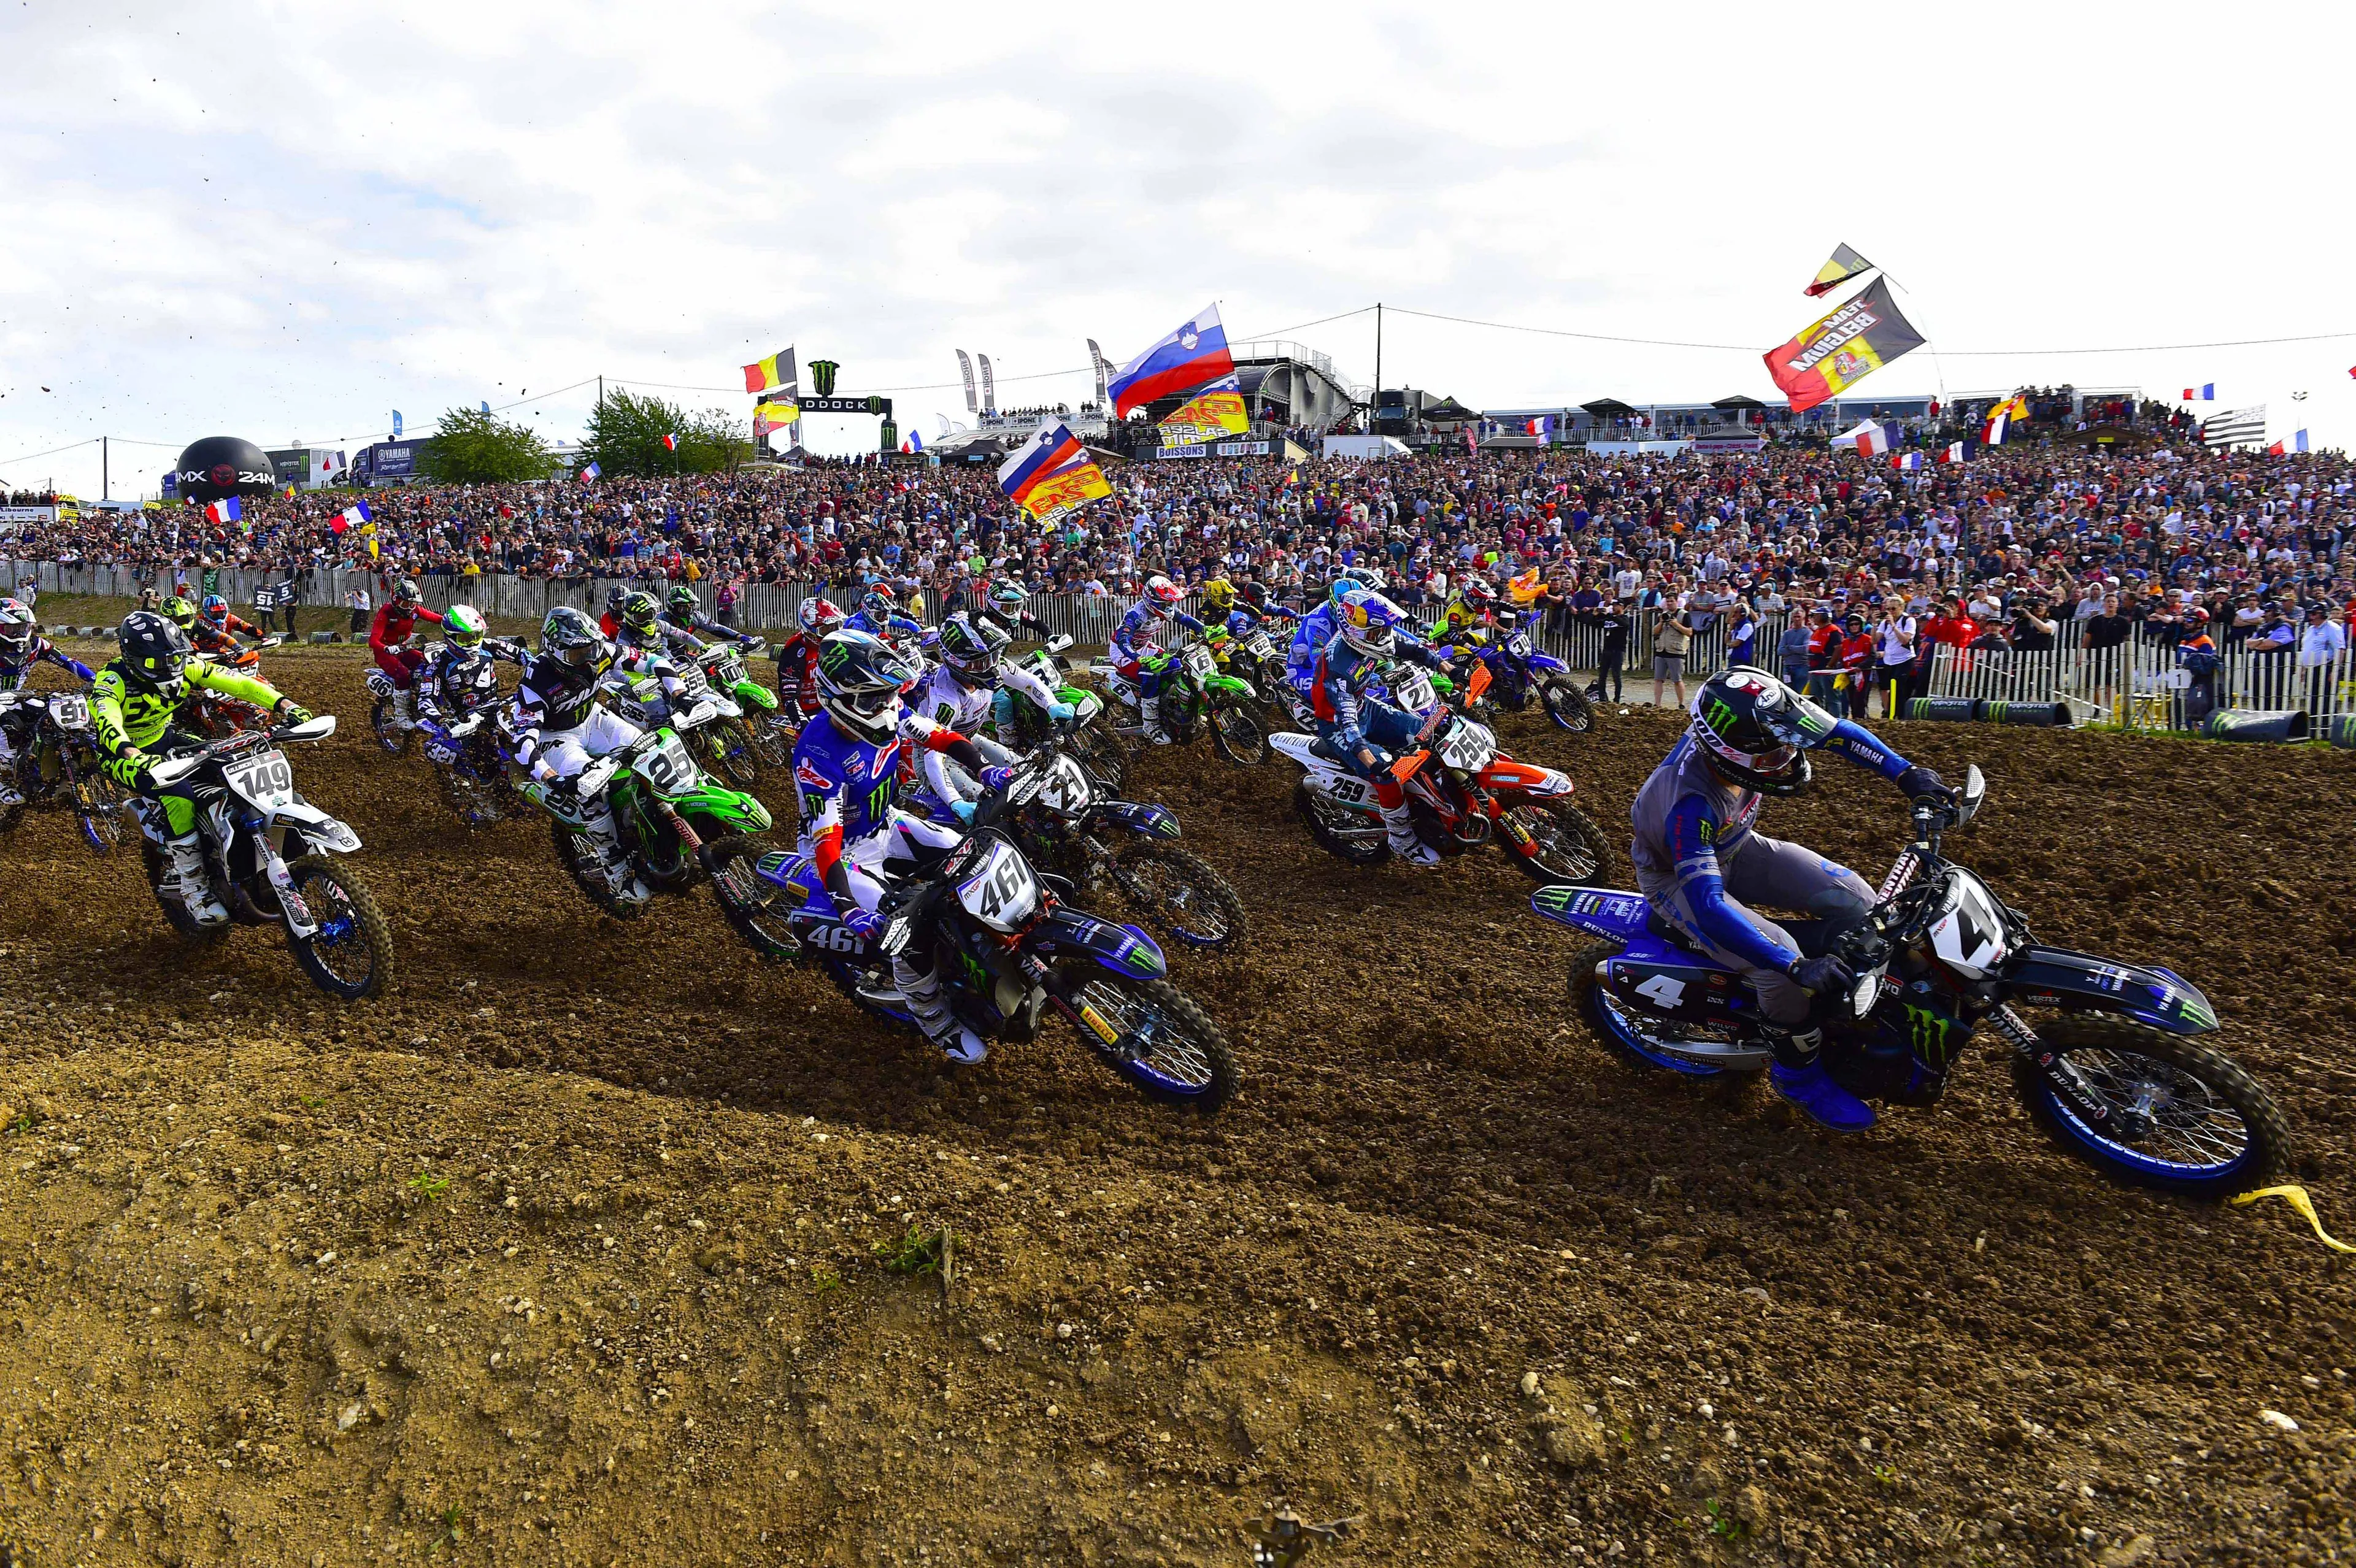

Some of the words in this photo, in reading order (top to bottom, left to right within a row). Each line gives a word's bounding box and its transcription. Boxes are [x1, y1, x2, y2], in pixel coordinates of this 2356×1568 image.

[385, 447, 410, 459] YAMAHA
[1159, 445, 1204, 458] BOISSONS
[257, 594, 274, 606] 15
[282, 586, 289, 597] 5
[1253, 638, 1271, 651] 62
[1513, 637, 1531, 656] 34
[1196, 654, 1209, 671] 6
[369, 677, 392, 695] 96
[1114, 681, 1128, 696] 6
[2176, 674, 2182, 686] 1
[1407, 682, 1431, 709] 22
[61, 702, 87, 724] 91
[217, 736, 259, 752] WRP
[428, 743, 456, 764] 321
[1276, 745, 1295, 755] DUNLOP
[1450, 726, 1486, 769] 259
[1850, 740, 1884, 765] YAMAHA
[228, 761, 253, 774] ULLRICH
[648, 742, 691, 789] 25
[1044, 763, 1058, 778] YAMAHA
[237, 763, 291, 800] 149
[1050, 763, 1085, 810] 21
[1328, 776, 1366, 802] 259
[1498, 818, 1524, 845] DUNLOP
[776, 856, 797, 874] YAMAHA
[969, 854, 991, 877] YAMAHA
[712, 871, 739, 906] DUNLOP
[964, 879, 981, 901] MXGP
[980, 848, 1027, 920] 461
[277, 884, 302, 923] BRIDGESTONE
[1569, 892, 1590, 914] YAMAHA
[1941, 886, 1960, 913] YAMAHA
[1582, 921, 1629, 944] DUNLOP
[1956, 886, 1997, 961] 4
[1114, 937, 1136, 959] YAMAHA
[1634, 974, 1686, 1009] 4
[2027, 995, 2062, 1004] VERTEX
[2158, 984, 2177, 1012] YAMAHA
[1085, 1009, 1115, 1041] PIRELLI
[1707, 1020, 1738, 1032] WILVO
[2049, 1070, 2097, 1112] DUNLOP
